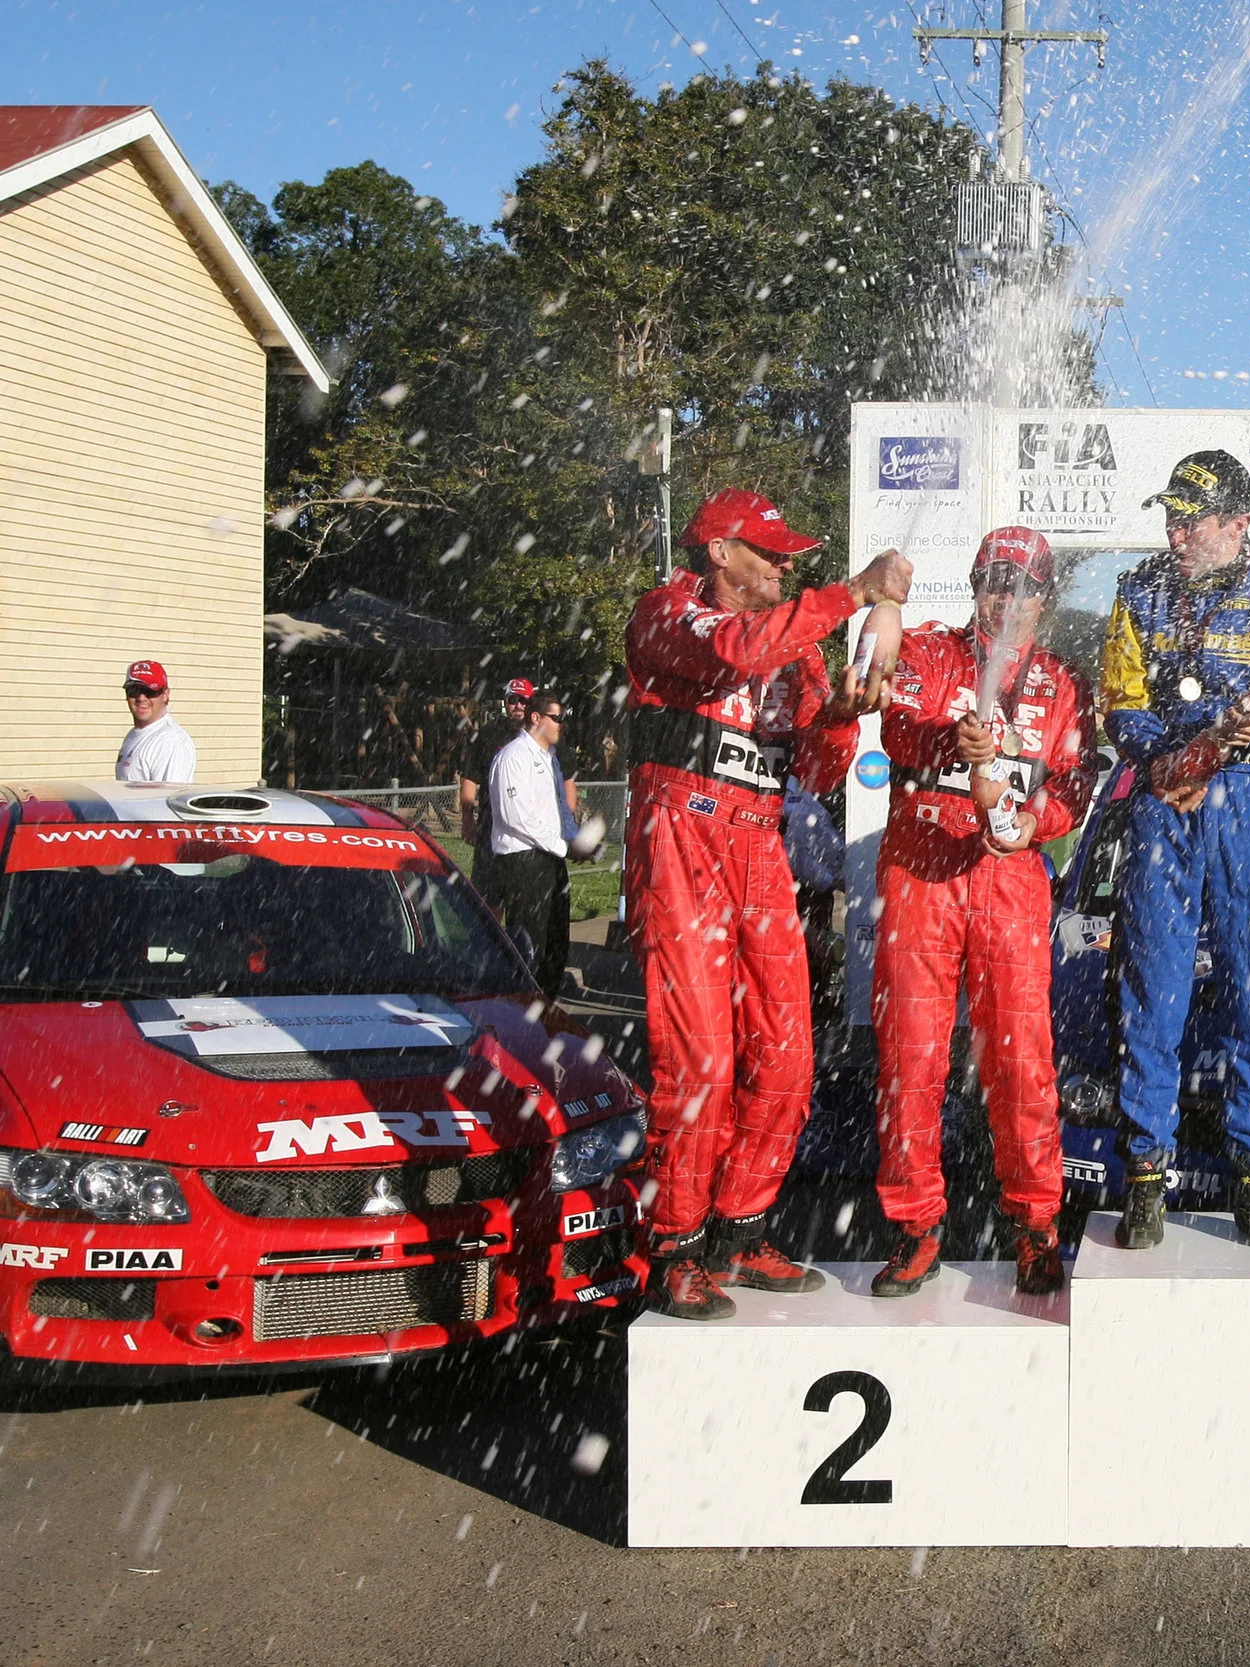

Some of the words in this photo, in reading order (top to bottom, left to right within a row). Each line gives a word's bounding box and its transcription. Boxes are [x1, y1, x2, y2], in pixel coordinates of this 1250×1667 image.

[1018, 490, 1118, 513] RALLY
[1017, 515, 1118, 526] CHAMPIONSHIP
[932, 533, 971, 547] Coast
[914, 582, 974, 593] YNDHAM
[36, 825, 419, 853] www.mrftyres.com
[61, 1122, 105, 1141] RALLI
[114, 1128, 148, 1145] ART
[256, 1111, 493, 1163] MRF
[1063, 1156, 1106, 1183] ELLI
[1164, 1168, 1222, 1193] OTUL
[569, 1208, 622, 1232] PIAA
[91, 1251, 176, 1270] PIAA
[801, 1369, 894, 1506] 2
